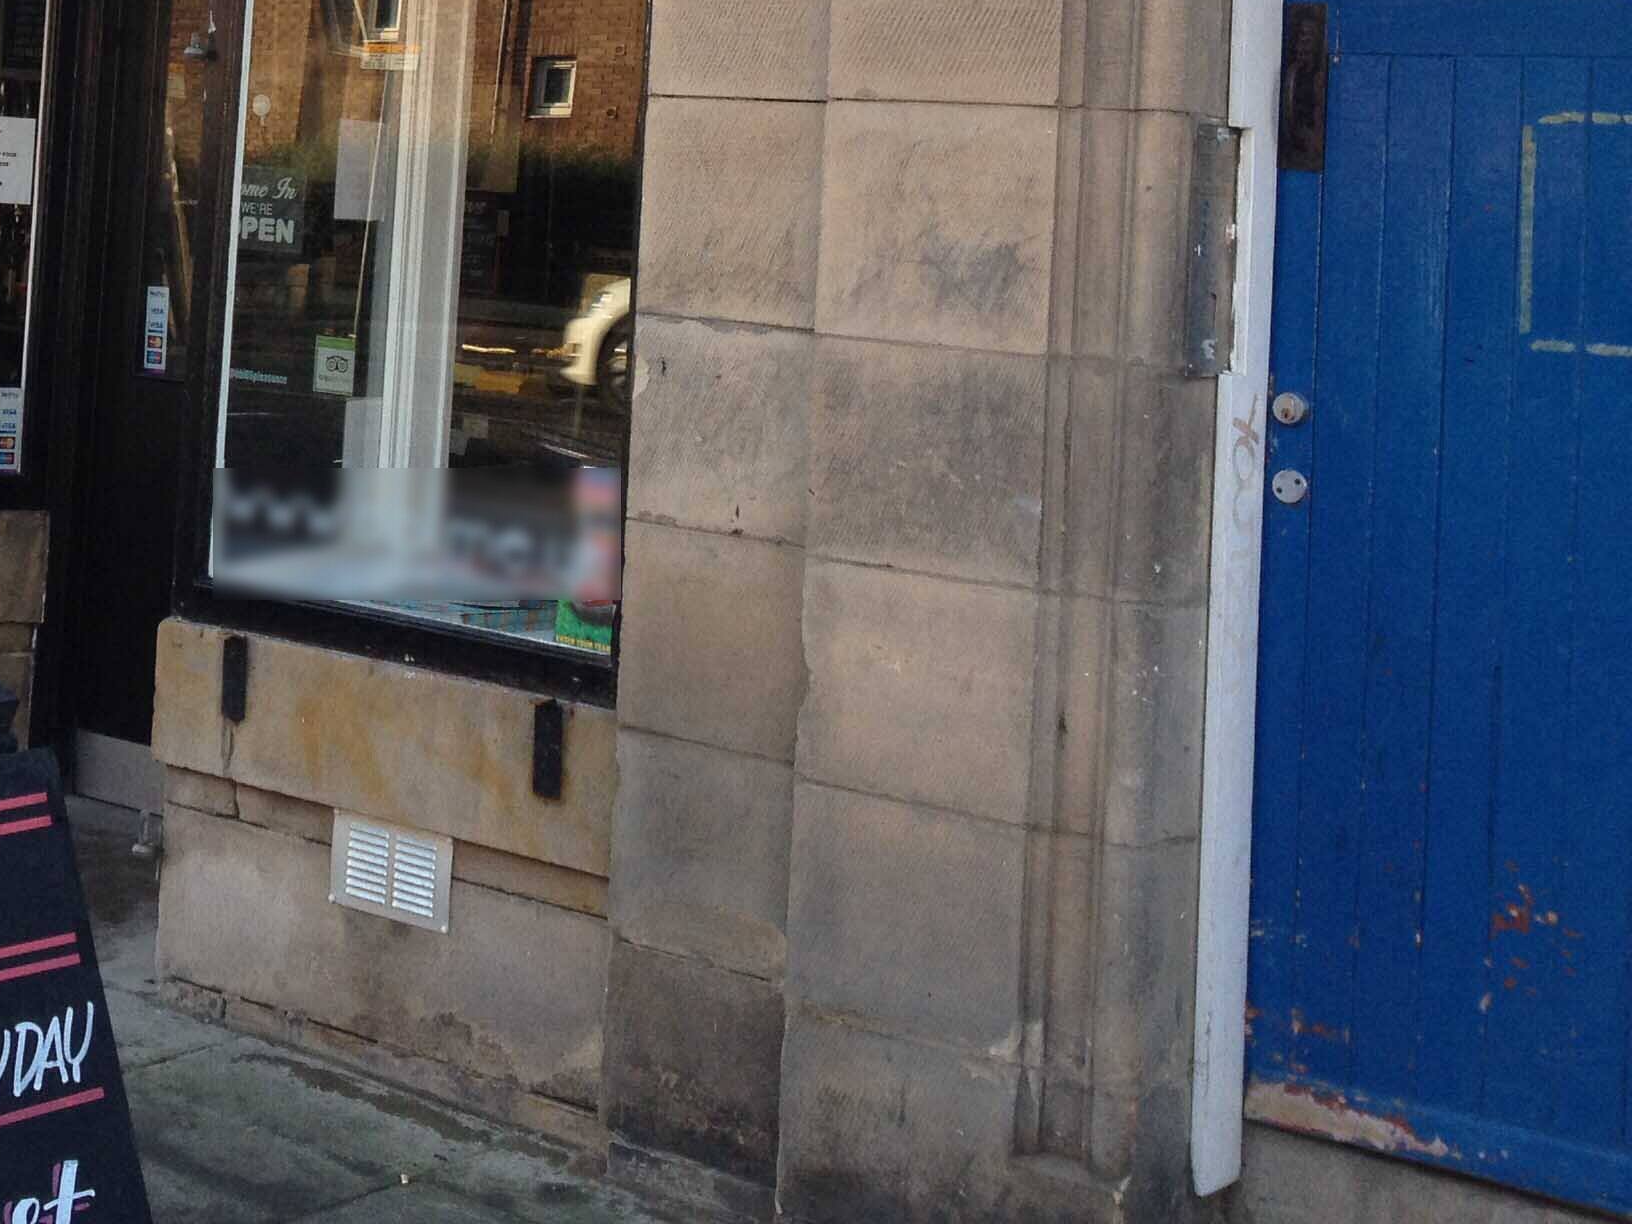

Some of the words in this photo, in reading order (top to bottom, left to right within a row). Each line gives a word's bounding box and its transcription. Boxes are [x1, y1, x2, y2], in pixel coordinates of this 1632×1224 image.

[272, 177, 296, 199] In
[241, 201, 273, 216] WE'RE
[239, 216, 294, 244] PEN
